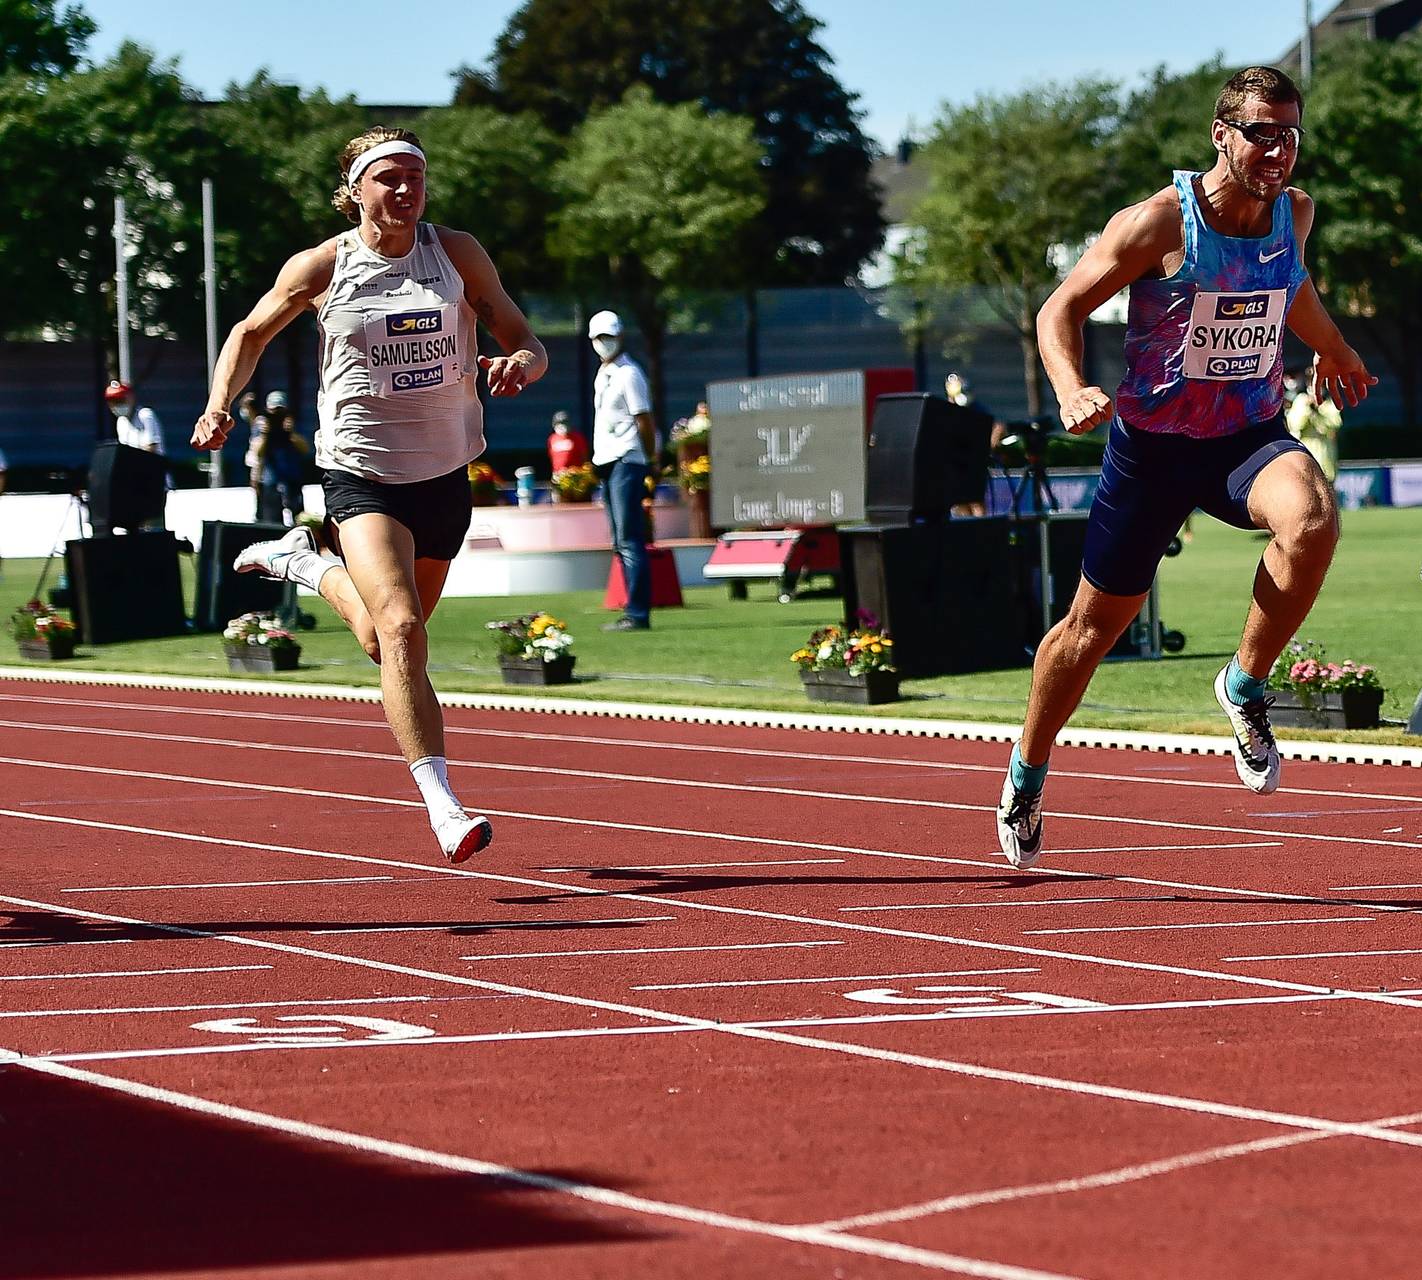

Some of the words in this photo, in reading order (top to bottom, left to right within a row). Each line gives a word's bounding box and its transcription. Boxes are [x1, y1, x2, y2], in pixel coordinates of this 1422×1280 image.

[1245, 301, 1265, 314] GLS
[416, 316, 438, 330] GLS
[1191, 324, 1277, 350] SYKORA
[371, 334, 457, 367] SAMUELSSON
[1230, 358, 1258, 370] PLAN
[414, 369, 442, 382] PLAN
